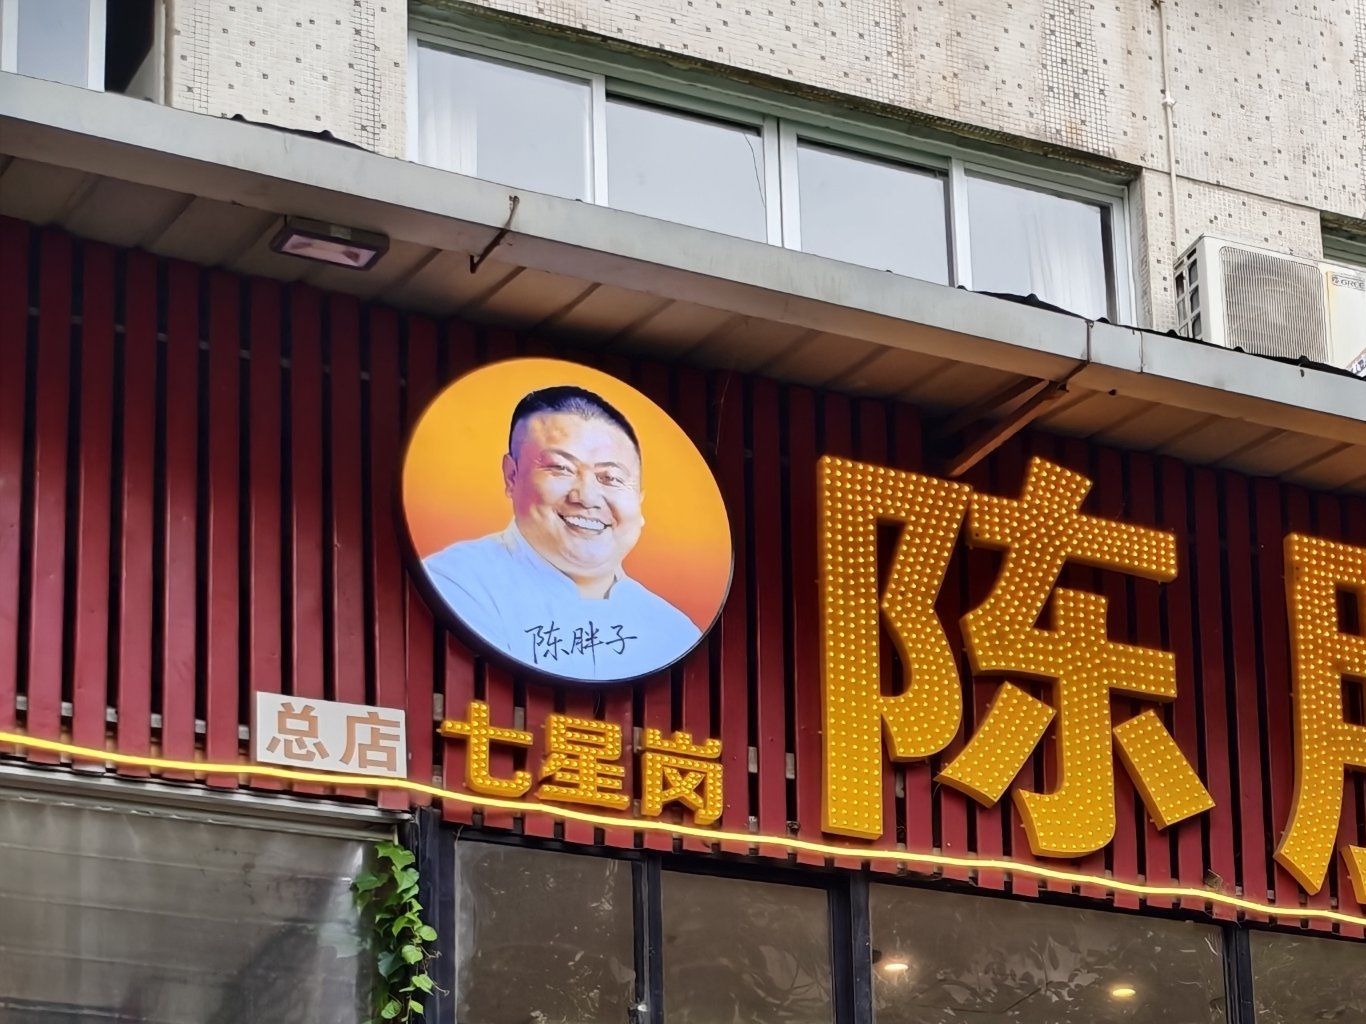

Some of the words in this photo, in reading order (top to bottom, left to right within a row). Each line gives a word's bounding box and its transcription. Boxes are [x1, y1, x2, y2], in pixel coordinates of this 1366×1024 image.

[524, 619, 638, 666] 陈胖子
[265, 701, 401, 772] 总店
[437, 699, 724, 826] 七星岗
